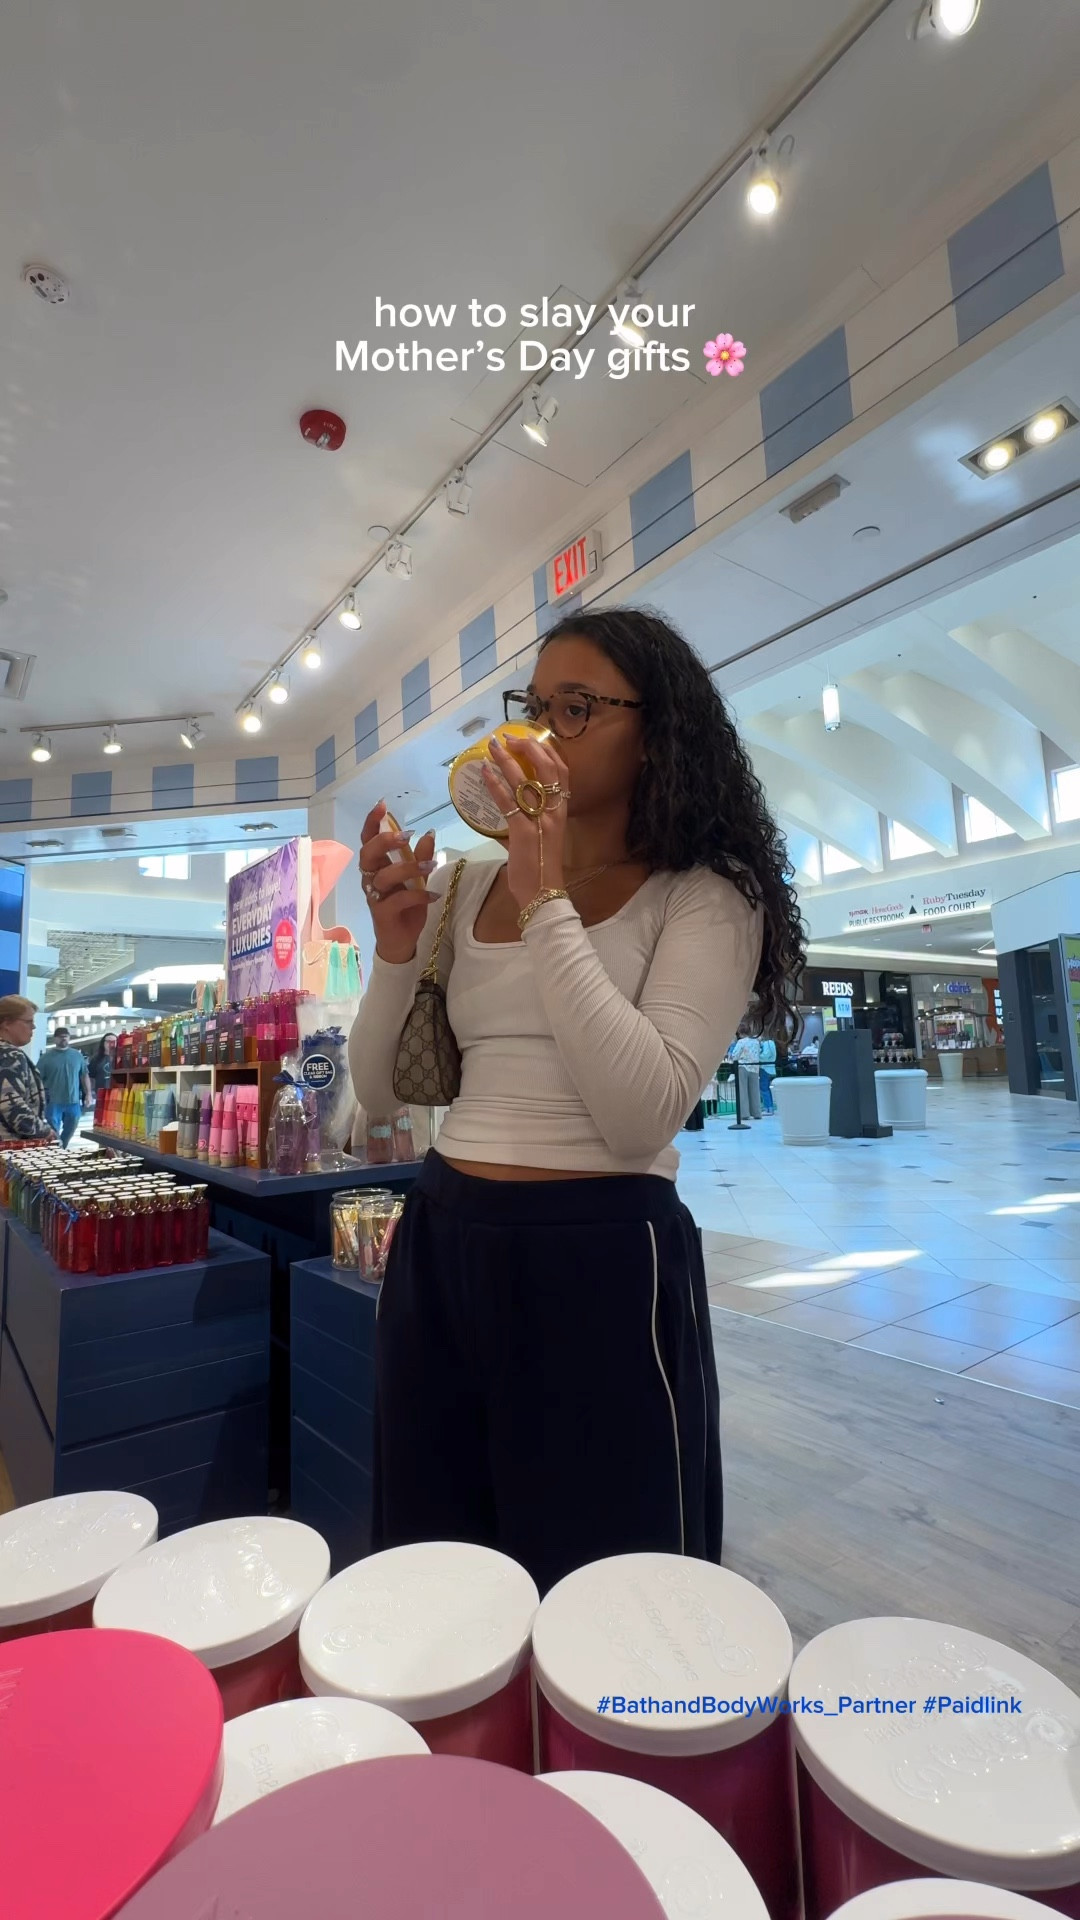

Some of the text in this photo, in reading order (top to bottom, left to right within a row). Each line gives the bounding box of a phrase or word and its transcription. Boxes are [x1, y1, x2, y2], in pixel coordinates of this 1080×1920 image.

[554, 535, 587, 596] EXIT
[923, 901, 977, 916] FOOD COURT
[232, 901, 274, 936] EVERYDAY
[848, 911, 905, 928] PUBLIC RESTROOMS
[231, 924, 272, 957] LUXURIES
[821, 981, 854, 997] REEDS
[307, 1062, 329, 1071] FREE
